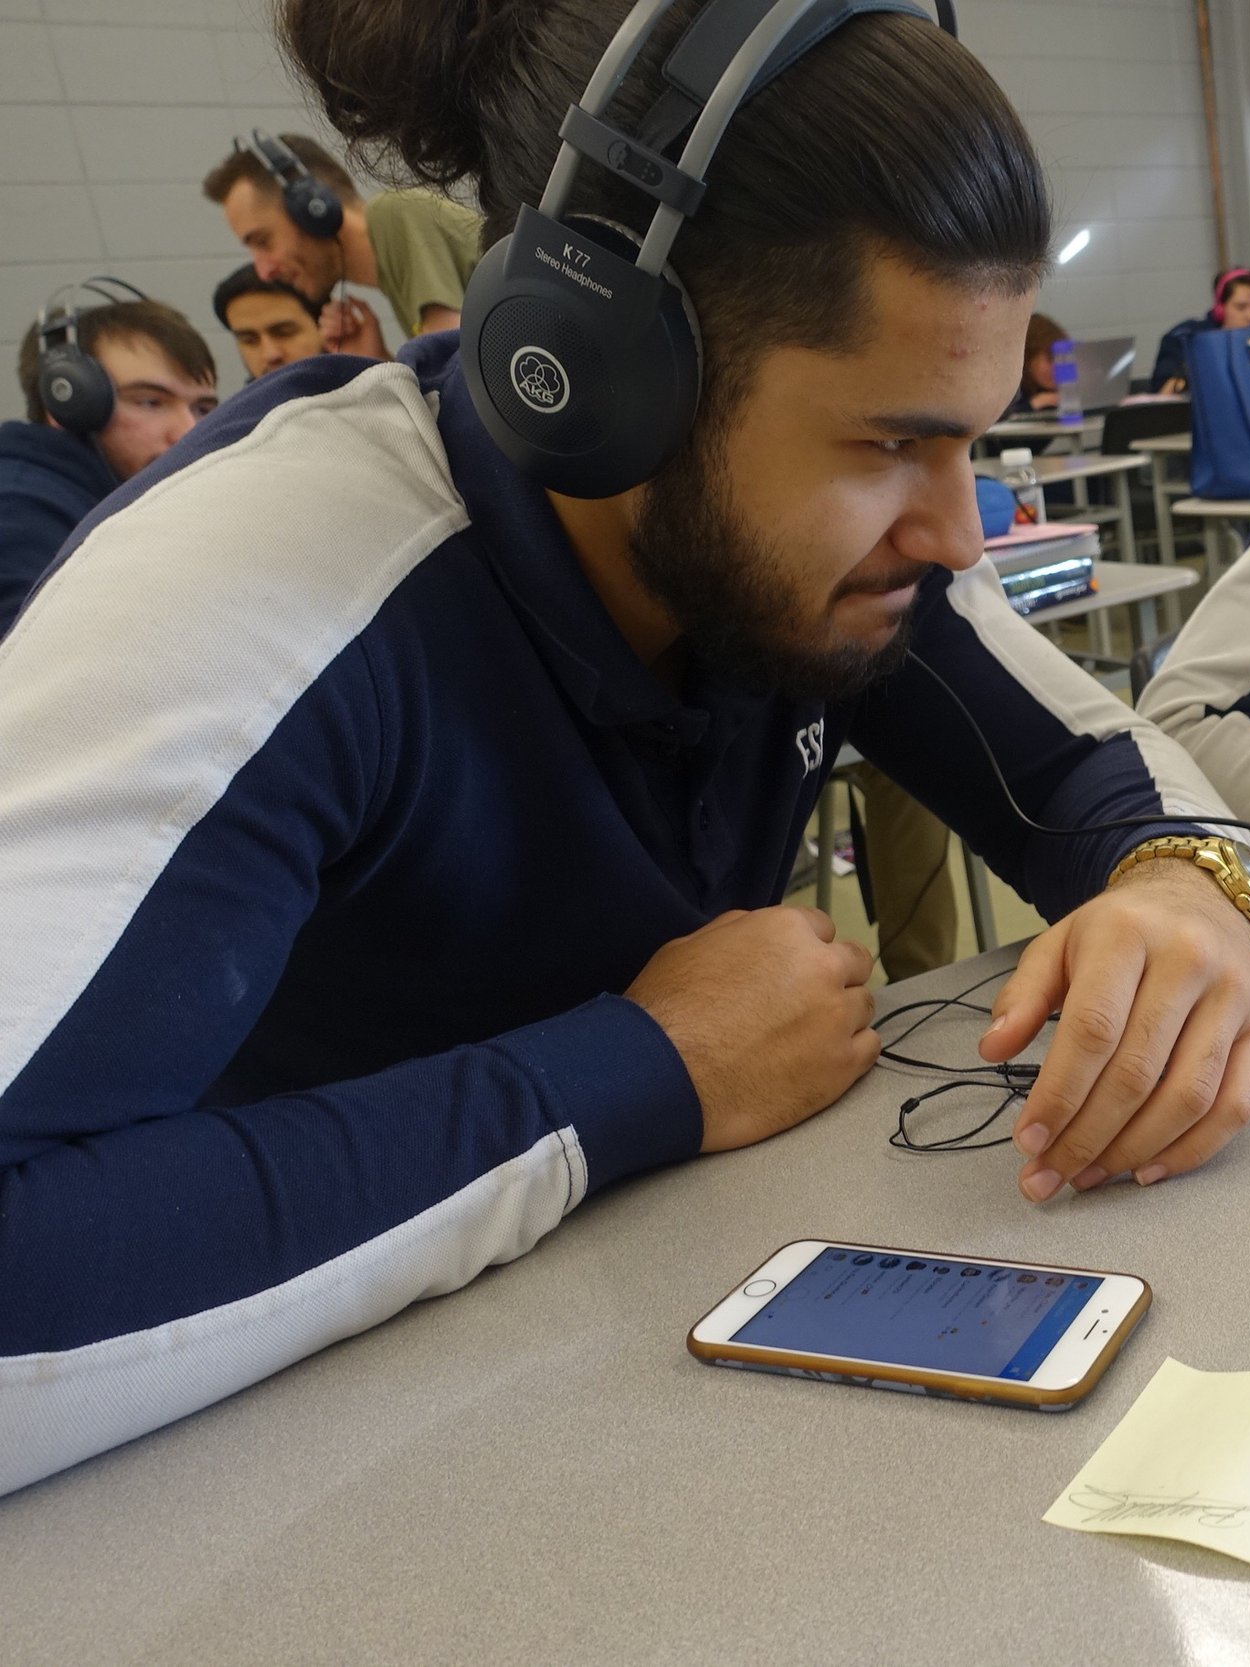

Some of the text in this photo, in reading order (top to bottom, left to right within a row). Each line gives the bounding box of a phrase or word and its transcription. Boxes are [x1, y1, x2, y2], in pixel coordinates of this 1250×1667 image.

[563, 243, 591, 268] K 77
[534, 247, 613, 300] Stereo Headphones
[519, 380, 554, 404] AKG
